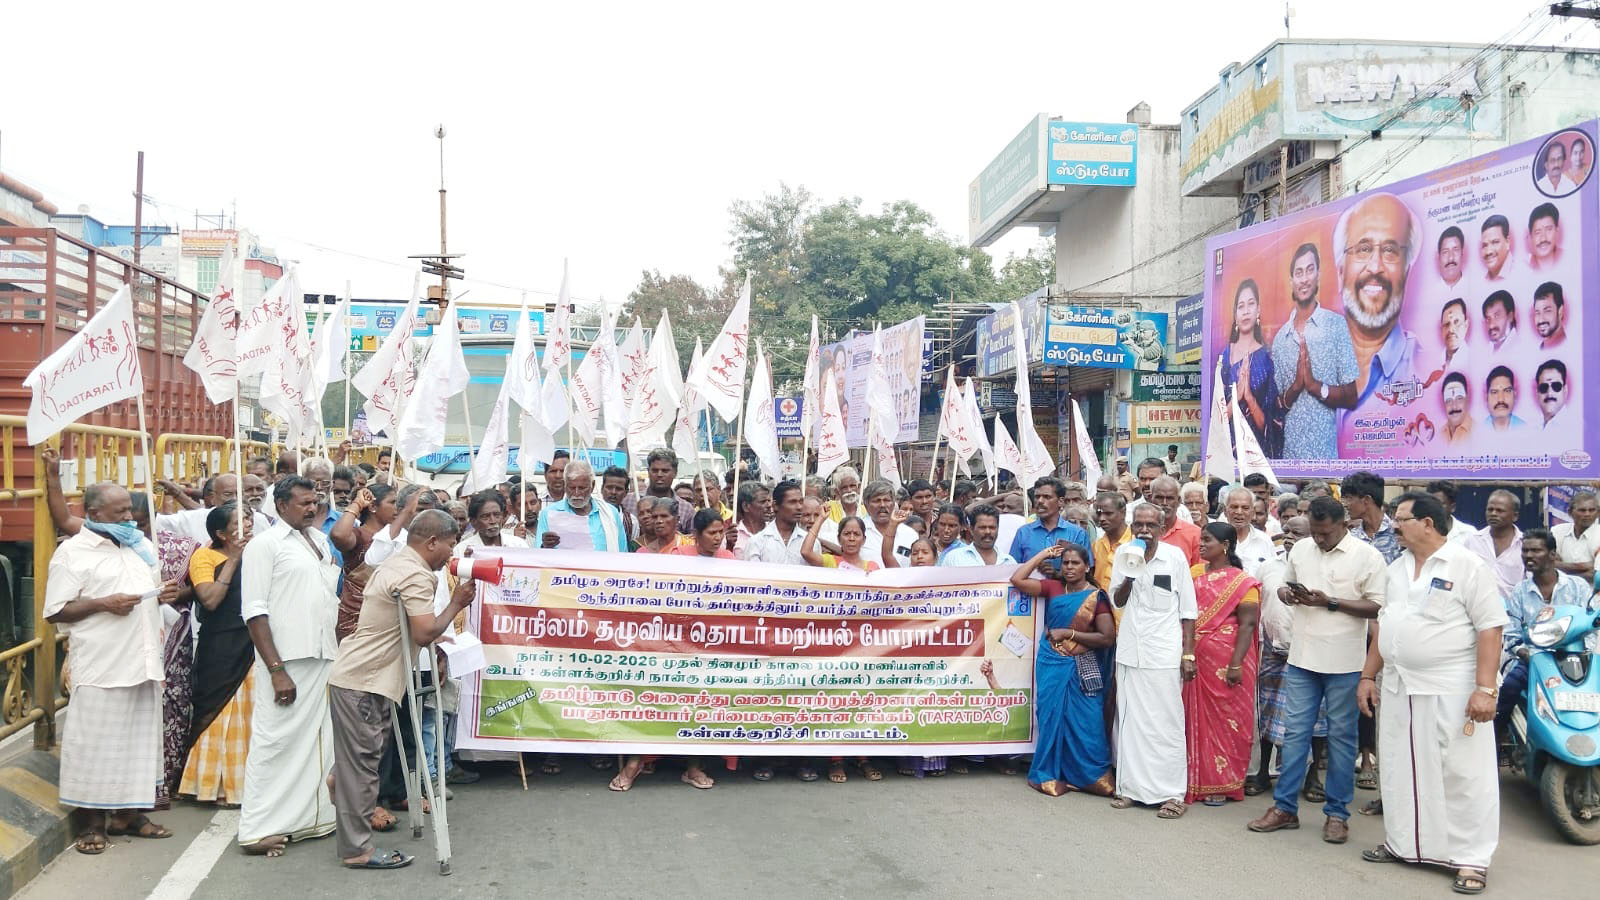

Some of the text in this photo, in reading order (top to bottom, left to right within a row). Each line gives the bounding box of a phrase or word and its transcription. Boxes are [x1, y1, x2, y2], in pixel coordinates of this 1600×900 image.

[1070, 130, 1118, 142] கோனிகா
[1056, 162, 1130, 180] ஸ்டுடியோ
[1067, 311, 1116, 324] கோனிகா
[1047, 345, 1126, 364] ஸ்டுடியோ
[1148, 409, 1182, 420] NEW
[551, 574, 600, 588] தமிழக
[604, 577, 649, 589] அரசே!
[655, 579, 820, 599] மாற்றுத்திறனாளிகளுக்கு
[824, 590, 889, 602] மாதாந்திர
[578, 593, 980, 617] ஆந்திராவை போல் தமிழகத்திலும் உயர்த்தி வழங்க வலியுறுத்தி!
[492, 610, 974, 654] மாநிலம் தழுவிய தொடர் மறியல் போராட்டம்
[516, 650, 554, 662] நாள்
[569, 652, 657, 666] 10-02-2026
[663, 656, 702, 670] முதல்
[707, 658, 762, 670] தினமும்
[766, 661, 812, 670] காலை
[817, 662, 860, 671] 10.00
[486, 664, 525, 676] இடம்
[540, 667, 644, 682] கள்ளக்குறிச்சி
[650, 671, 699, 684] நான்கு
[754, 673, 806, 686] சந்திப்பு
[811, 674, 870, 686] (சிக்னல்)
[876, 674, 973, 686] கள்ளக்குறிச்சி.
[540, 686, 1027, 708] தமிழ்நாடு அனைத்து வகை மாற்றுத்திறனாளிகள் மற்றும்
[562, 706, 1009, 726] பாதுகாப்போர் உரிமைகளுக்கான சங்கம் (TARATDAC)
[678, 726, 908, 740] கள்ளக்குறிச்சி மாவட்டம்.
